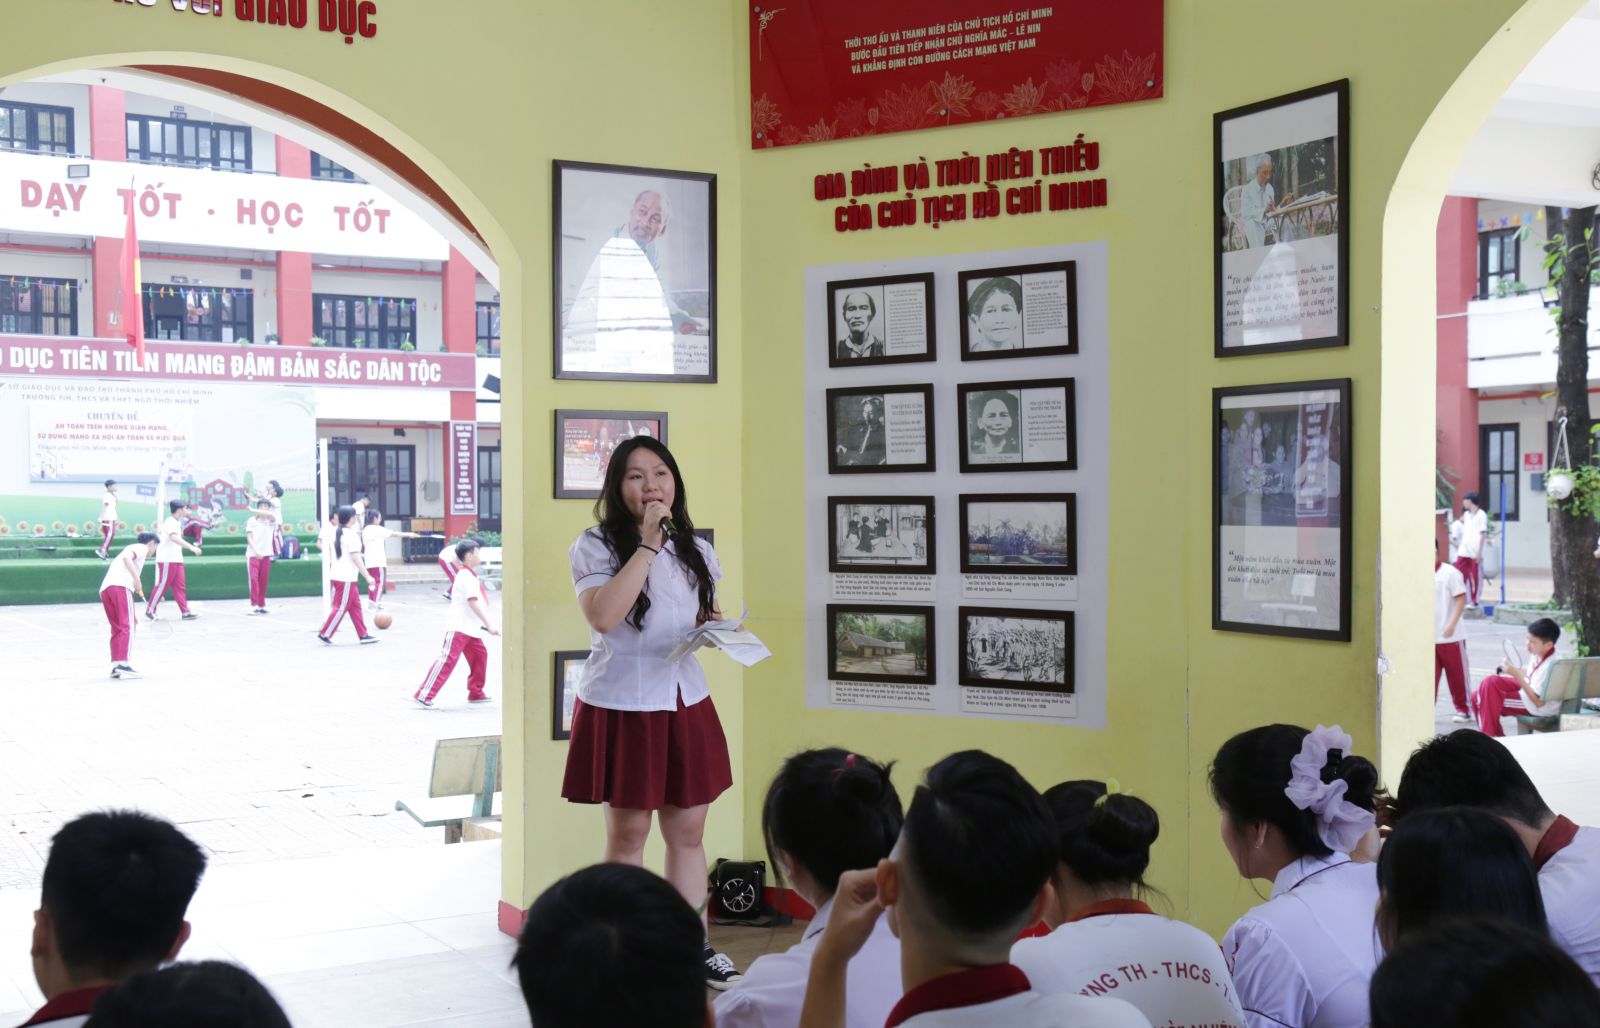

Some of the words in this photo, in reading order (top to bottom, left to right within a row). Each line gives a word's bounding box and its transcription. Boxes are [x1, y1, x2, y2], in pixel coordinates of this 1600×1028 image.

[319, 0, 377, 44] DỤC
[845, 38, 861, 49] THỜI
[863, 36, 877, 46] THƠ
[890, 30, 900, 42] VÀ
[902, 28, 926, 40] THANH
[928, 24, 946, 36] NIÊN
[948, 20, 962, 33] CỦA
[964, 17, 980, 31] CHỦ
[982, 16, 1000, 29] TỊCH
[1003, 10, 1014, 24] HỒ
[1016, 8, 1030, 22] CHÍ
[1032, 7, 1052, 20] MINH
[851, 50, 870, 61] BƯỚC
[872, 44, 887, 58] ĐẦU
[889, 43, 905, 56] TIÊN
[907, 39, 923, 52] TIẾP
[925, 37, 945, 50] NHẬN
[946, 32, 962, 46] CHỦ
[964, 30, 988, 44] NGHĨA
[990, 26, 1008, 40] MÁC
[1016, 24, 1026, 36] LÊ
[1028, 23, 1041, 34] NIN
[852, 62, 862, 74] VÀ
[888, 59, 906, 71] ĐỊNH
[908, 55, 924, 66] CON
[925, 49, 951, 64] ĐƯỜNG
[952, 46, 974, 59] CÁCH
[976, 44, 998, 57] MẠNG
[1000, 40, 1016, 53] VIỆT
[1018, 38, 1036, 49] NAM
[815, 172, 847, 201] GIA
[850, 162, 898, 197] ĐÌNH
[904, 156, 930, 190] VÀ
[935, 151, 980, 187] THỜI
[986, 147, 1034, 182] NIÊN
[1039, 133, 1100, 176] THIẾU
[20, 180, 88, 218] DẠY
[116, 182, 182, 220] TỐT
[236, 198, 304, 234] HỌC
[334, 199, 391, 234] TỐT
[835, 198, 873, 232] CỦA
[878, 192, 917, 228] CHỦ
[921, 194, 966, 229] TỊCH
[972, 181, 1000, 219] HỒ
[1006, 180, 1042, 215] CHÍ
[1048, 178, 1108, 212] MINH
[10, 346, 54, 373] DỤC
[60, 346, 108, 371] TIÊN
[165, 352, 225, 375] MANG
[230, 352, 274, 380] ĐẬM
[280, 351, 320, 378] BẢN
[324, 352, 362, 380] SẮC
[366, 357, 404, 381] DÂN
[408, 360, 441, 386] TỘC
[1118, 963, 1148, 982] TH
[1161, 962, 1211, 984] THCS
